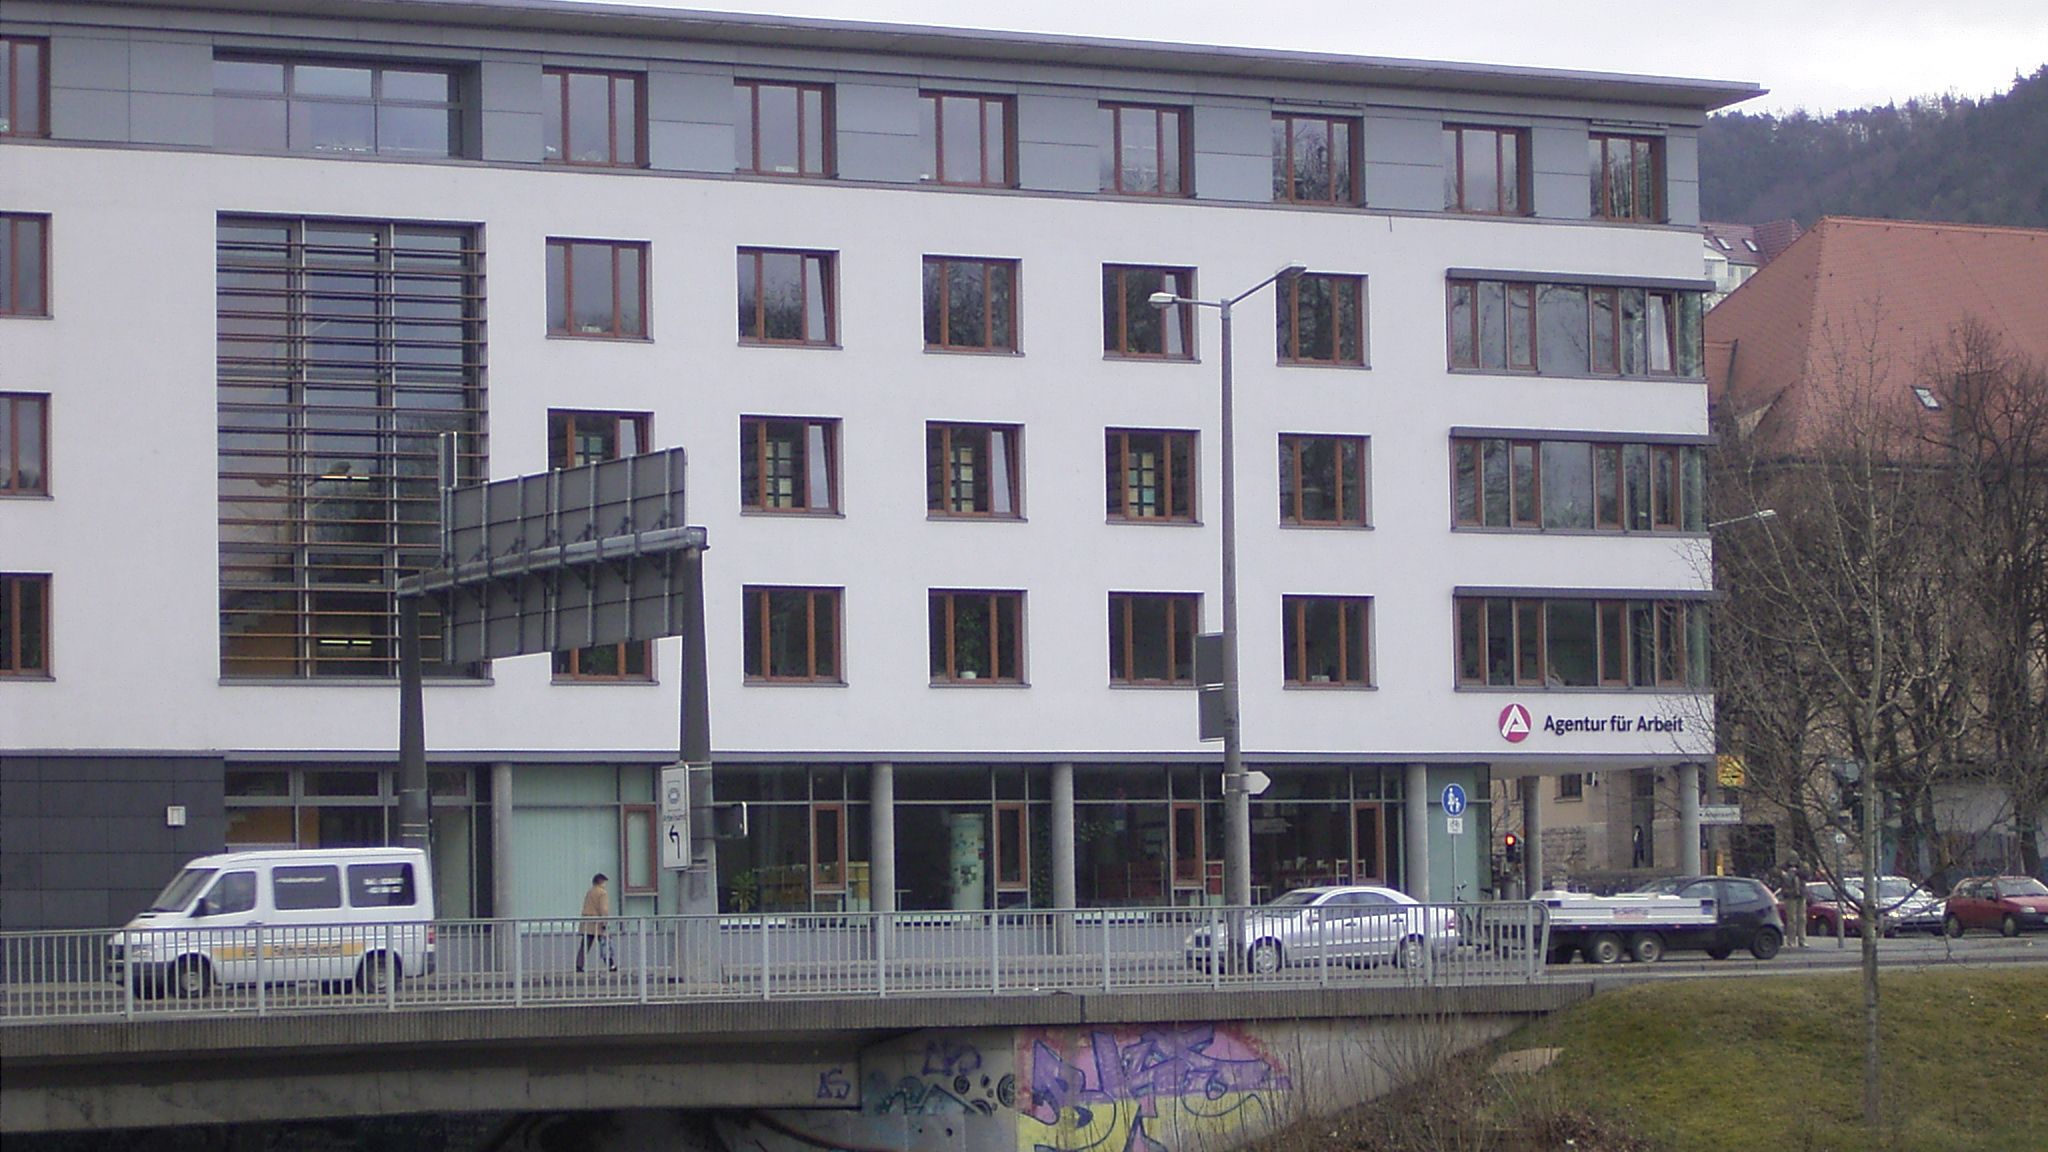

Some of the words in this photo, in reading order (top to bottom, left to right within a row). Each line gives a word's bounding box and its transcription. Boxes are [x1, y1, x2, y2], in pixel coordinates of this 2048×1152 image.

[1544, 714, 1608, 736] Agentur
[1610, 714, 1633, 732] für
[1636, 714, 1684, 732] Arbeit
